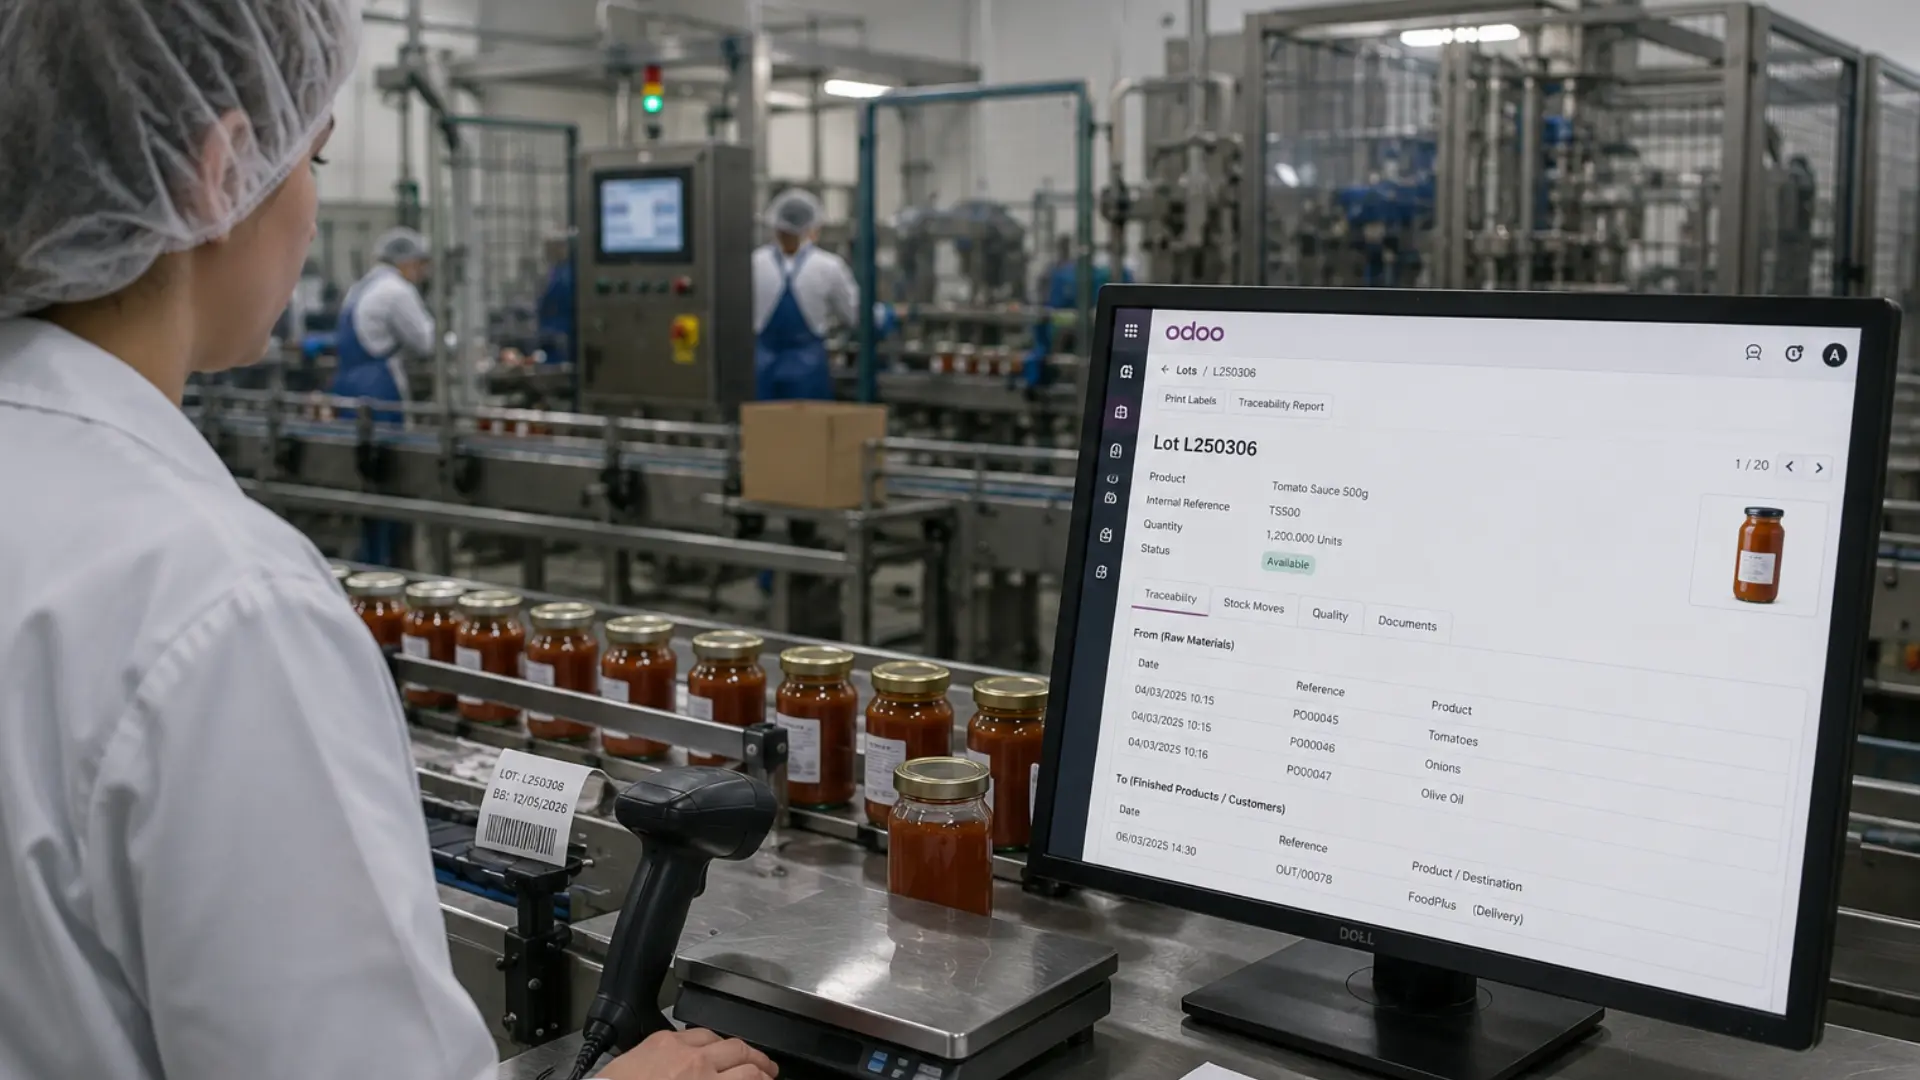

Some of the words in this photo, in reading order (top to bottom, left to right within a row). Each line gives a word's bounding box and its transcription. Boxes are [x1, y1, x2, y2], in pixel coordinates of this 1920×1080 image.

[1165, 321, 1224, 342] odoo
[1829, 349, 1840, 361] A
[1176, 365, 1197, 376] Lots
[1213, 366, 1256, 378] L250306
[1165, 393, 1186, 404] Print
[1188, 395, 1217, 405] Labels
[1238, 397, 1291, 411] Traceability
[1293, 400, 1324, 412] Report
[1154, 434, 1180, 451] Lot
[1184, 437, 1257, 456] L250306
[1753, 459, 1769, 471] 20
[1149, 471, 1186, 484] Product
[1272, 481, 1308, 493] Tomato
[1310, 484, 1340, 496] Sauce
[1342, 486, 1369, 501] 500g
[1146, 495, 1181, 507] Internal
[1183, 498, 1230, 511] Reference
[1144, 519, 1183, 534] Quantity
[1317, 535, 1342, 546] Units
[1141, 543, 1170, 555] Status
[1267, 557, 1310, 570] Available
[1224, 597, 1250, 610] Stock
[1253, 601, 1285, 614] Moves
[1312, 608, 1349, 623] Quality
[1378, 615, 1437, 632] Documents
[1133, 628, 1158, 640] From
[1161, 632, 1185, 643] (Raw
[1187, 635, 1234, 651] Materials)
[1138, 658, 1159, 670] Date
[1296, 680, 1345, 697] Reference
[1432, 700, 1472, 716] Product
[1428, 729, 1478, 747] Tomatoes
[1425, 759, 1461, 774] Onions
[492, 788, 510, 801] BB:
[1116, 773, 1128, 784] To
[1130, 776, 1174, 792] (Finished
[1175, 784, 1219, 801] Products
[1228, 794, 1286, 816] Customers)
[1421, 788, 1447, 802] Olive
[1449, 793, 1464, 805] Oil
[1119, 804, 1140, 816] Date
[1279, 835, 1328, 853] Reference
[1276, 864, 1332, 884] OUT/00078
[1412, 861, 1453, 878] Product
[1462, 871, 1522, 892] Destination
[1408, 891, 1456, 910] FoodPlus
[1473, 904, 1524, 926] (Delivery)
